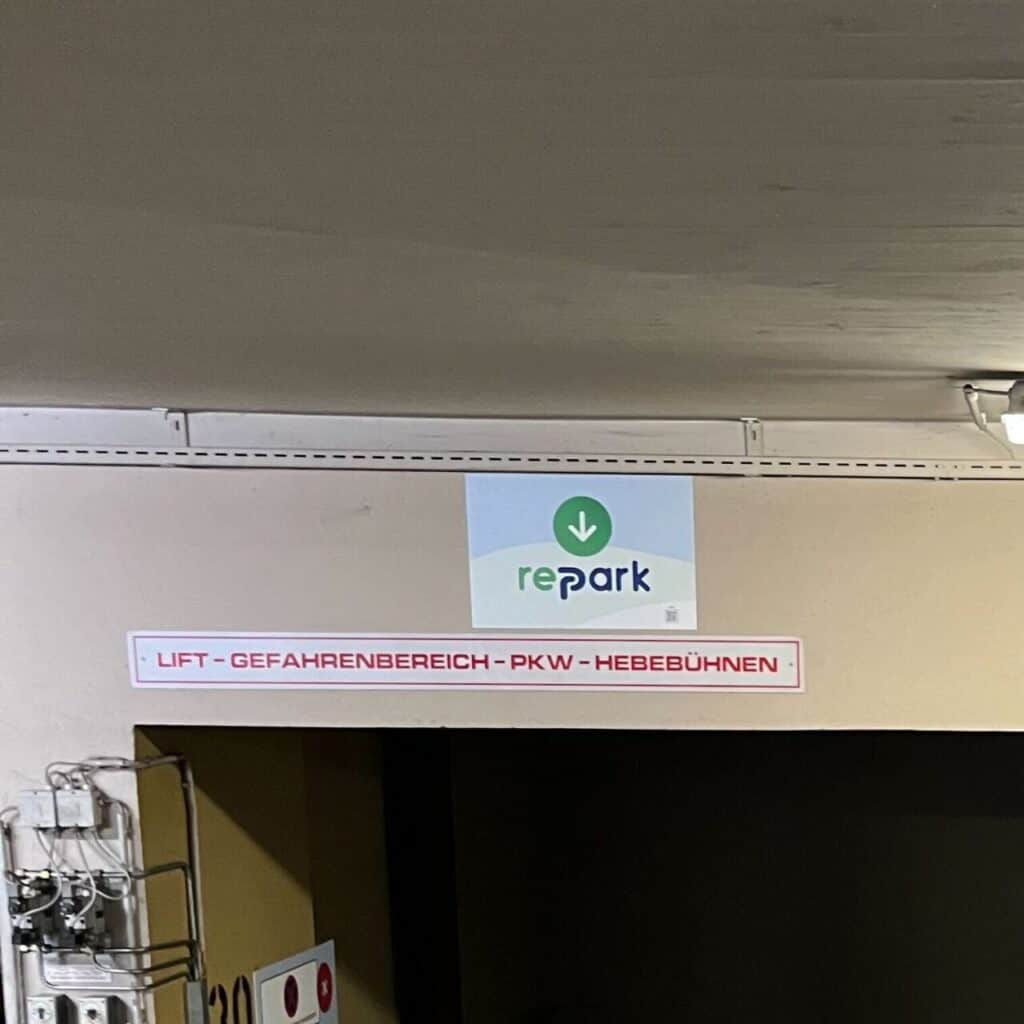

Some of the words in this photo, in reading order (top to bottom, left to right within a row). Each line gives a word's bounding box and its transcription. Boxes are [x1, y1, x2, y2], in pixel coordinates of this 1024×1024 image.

[518, 560, 650, 600] repark
[157, 652, 208, 668] LIFT
[230, 652, 489, 670] GEFAHRENBEREICH
[510, 654, 573, 670] PKW
[595, 651, 778, 673] HEBEBÜHNEN
